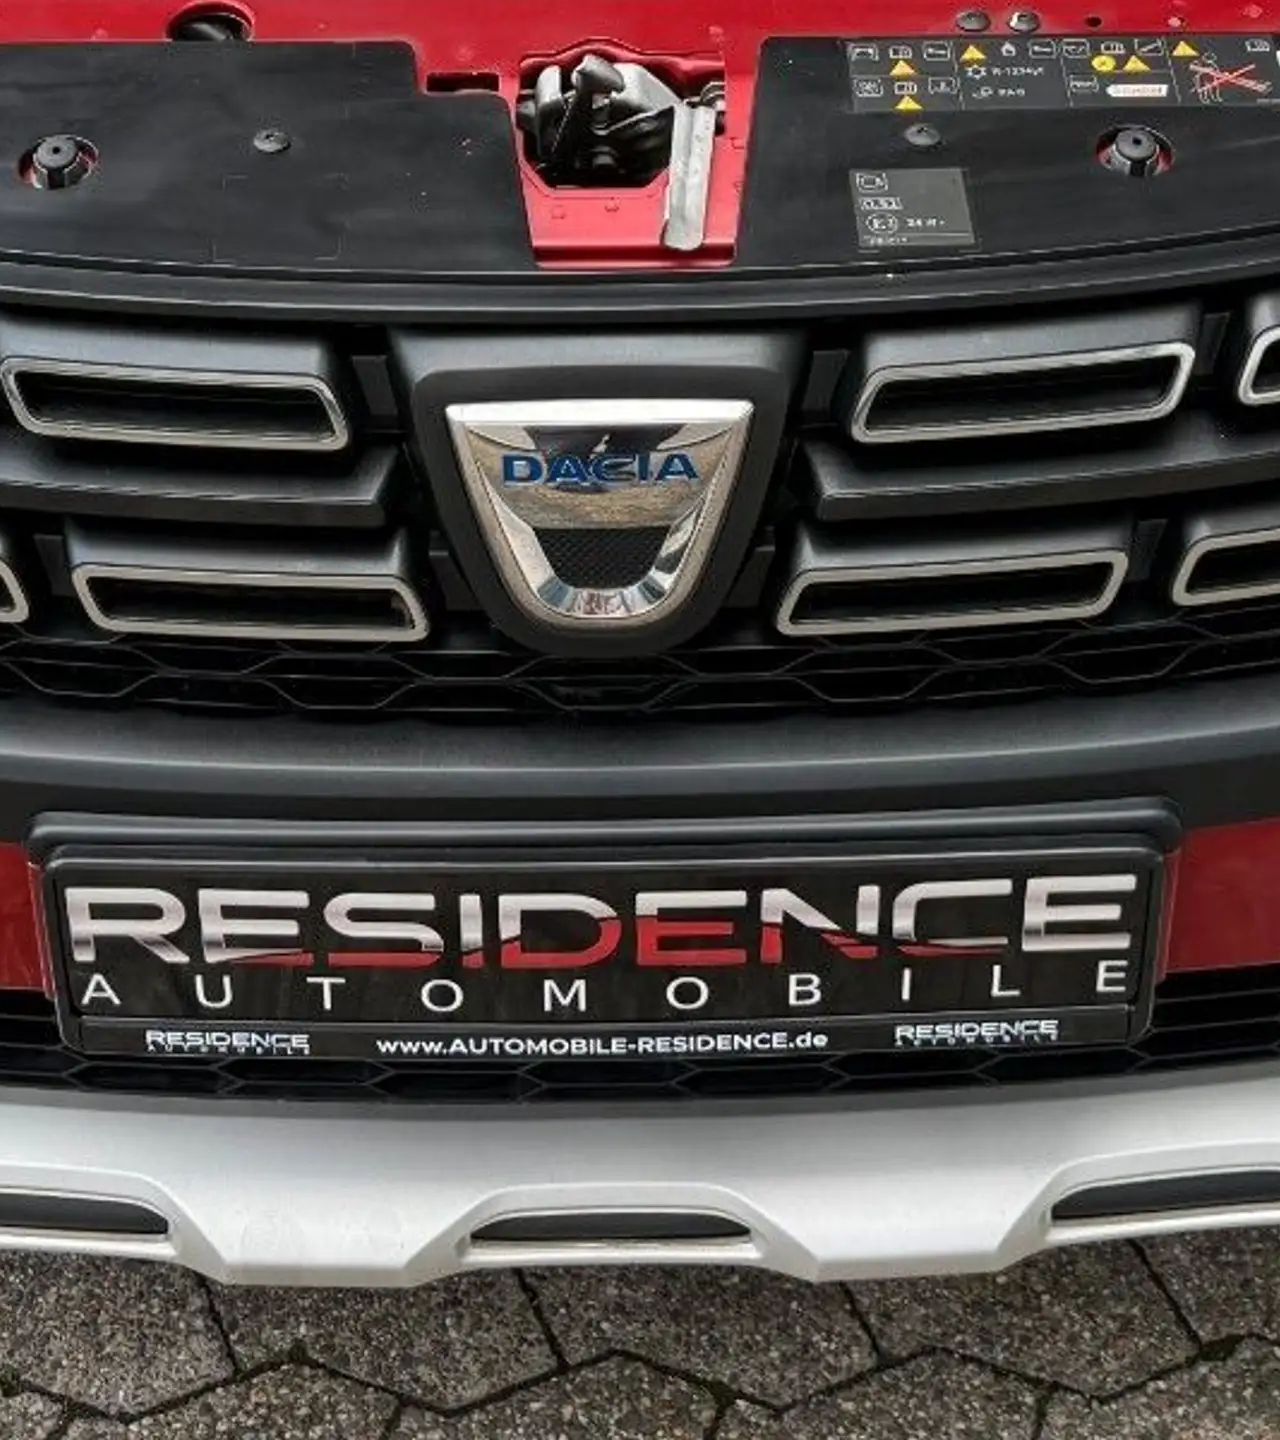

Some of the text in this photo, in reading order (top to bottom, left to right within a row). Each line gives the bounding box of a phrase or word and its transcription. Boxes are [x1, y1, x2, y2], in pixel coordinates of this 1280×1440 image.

[500, 452, 702, 488] DACIA
[63, 873, 1137, 970] RESIDENCE
[80, 960, 1129, 1013] AUTOMOBILE
[145, 1028, 310, 1049] RESIDENCE
[376, 1032, 829, 1056] www.AUTOMOBILE-RESIDENCE.de
[894, 1019, 1059, 1040] RESIDENCE
